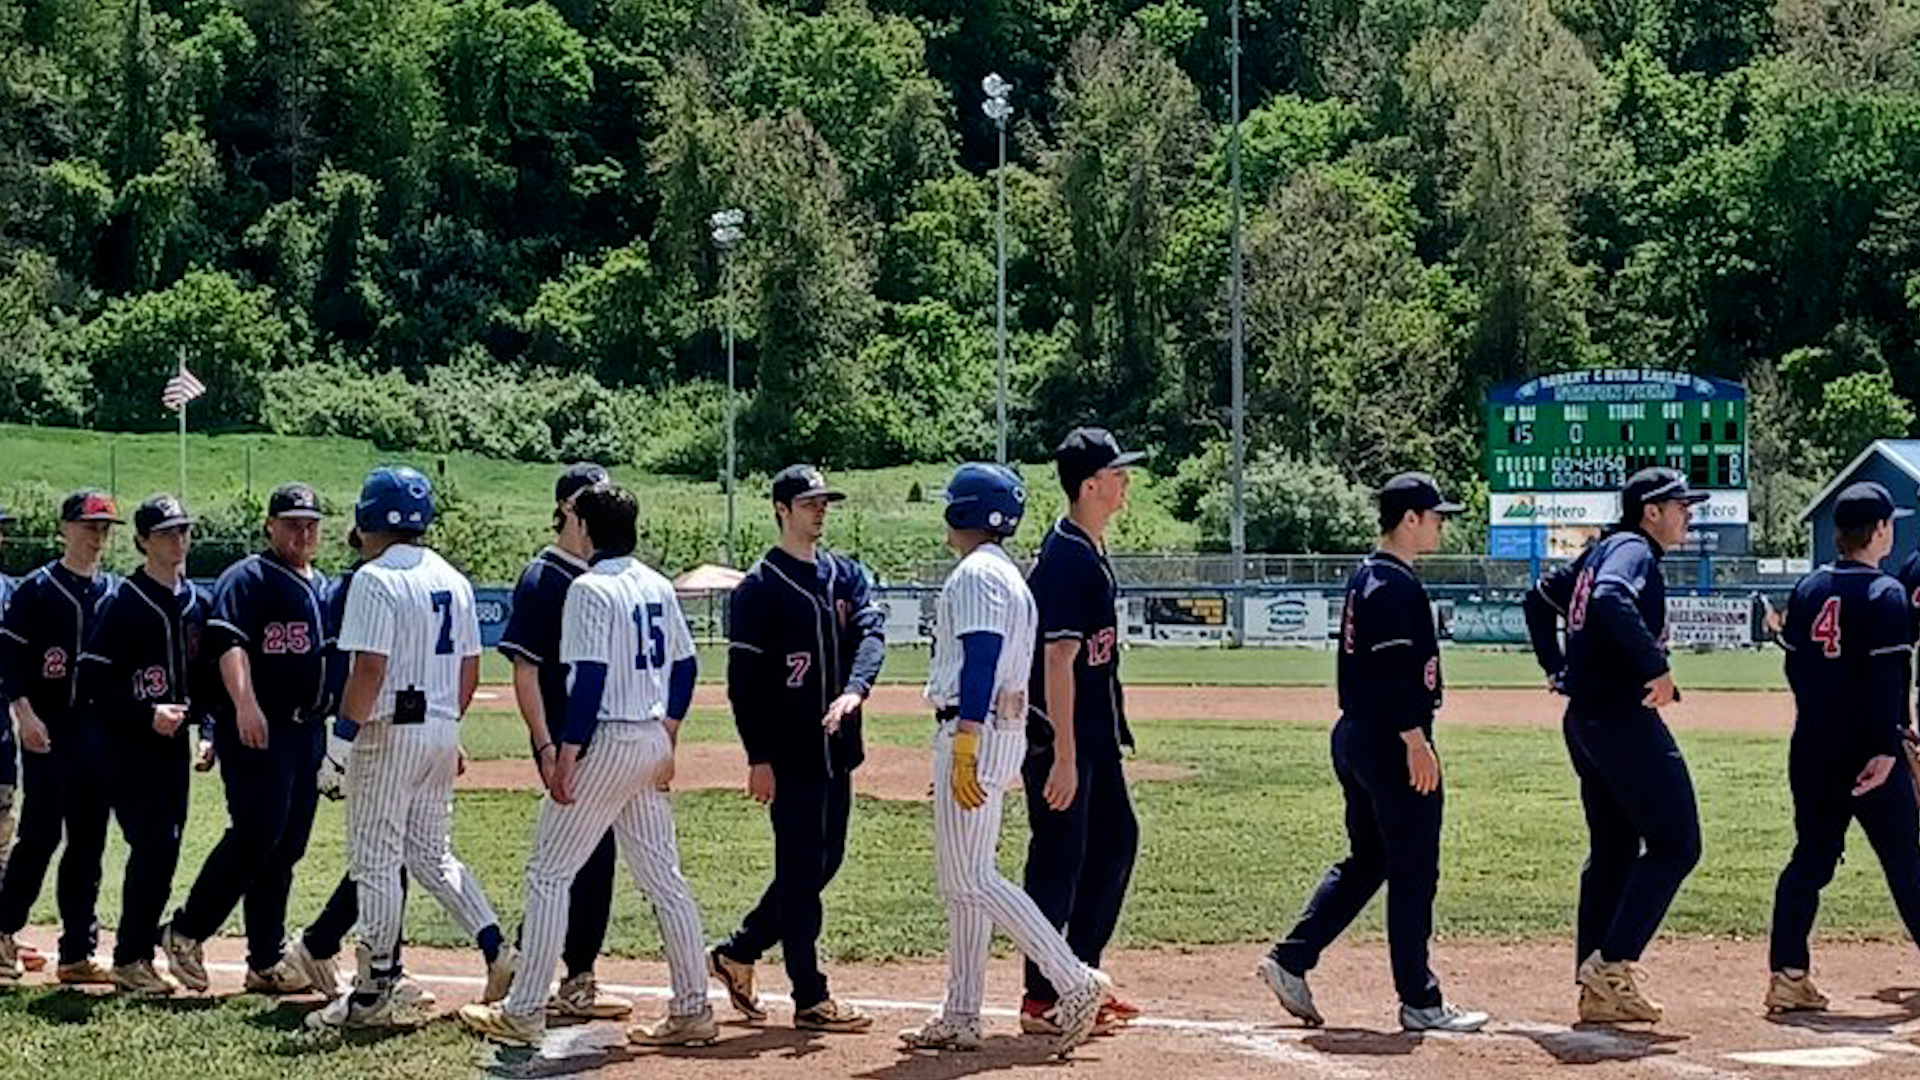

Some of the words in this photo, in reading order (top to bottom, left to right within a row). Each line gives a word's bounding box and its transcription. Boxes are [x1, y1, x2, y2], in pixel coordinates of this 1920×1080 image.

[1514, 423, 1534, 444] 15
[1569, 422, 1583, 444] 0
[1534, 504, 1587, 518] Antero
[262, 621, 311, 654] 25
[430, 590, 454, 655] 7
[633, 602, 665, 669] 15
[1811, 596, 1841, 658] 4
[43, 646, 67, 679] 2
[786, 651, 812, 688] 7
[132, 664, 169, 700] 13
